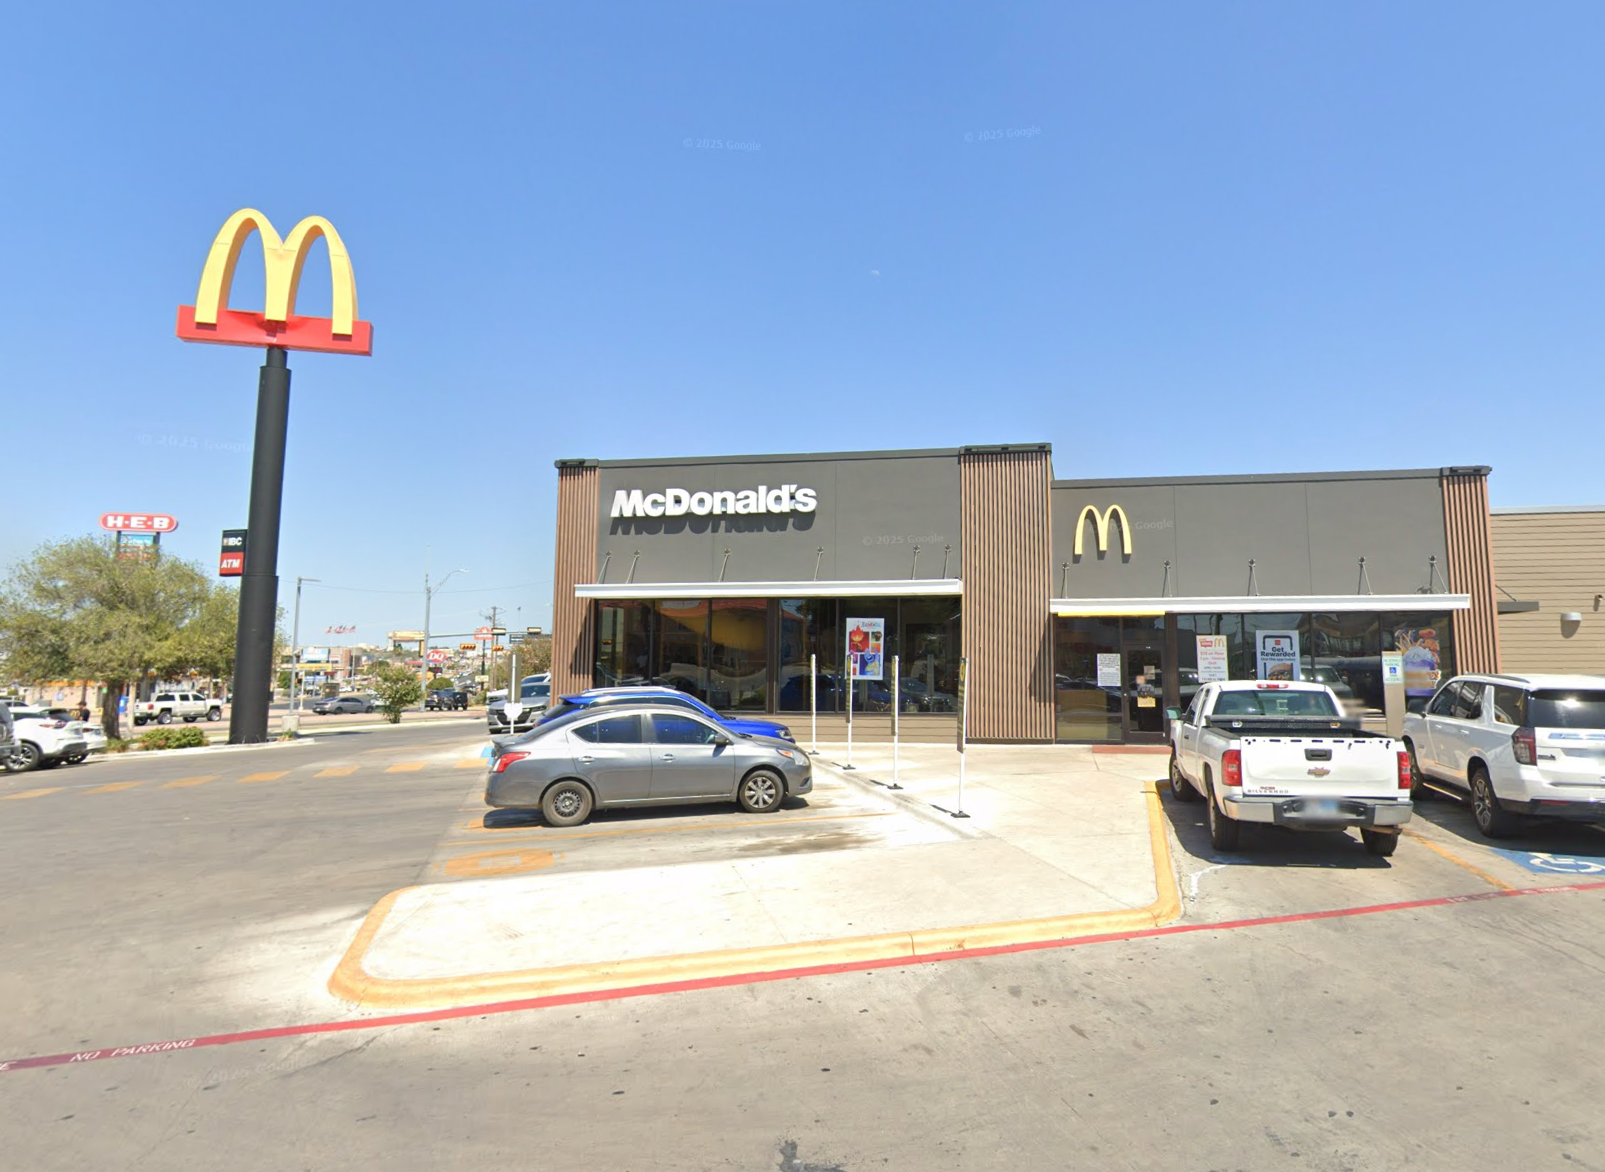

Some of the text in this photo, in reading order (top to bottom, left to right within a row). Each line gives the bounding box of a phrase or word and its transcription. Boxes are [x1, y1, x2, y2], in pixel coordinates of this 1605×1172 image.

[610, 484, 818, 517] McDonald's
[227, 536, 242, 546] IBC
[221, 558, 241, 569] ATM
[429, 652, 444, 660] DQ
[69, 1039, 196, 1062] NO PARKING
